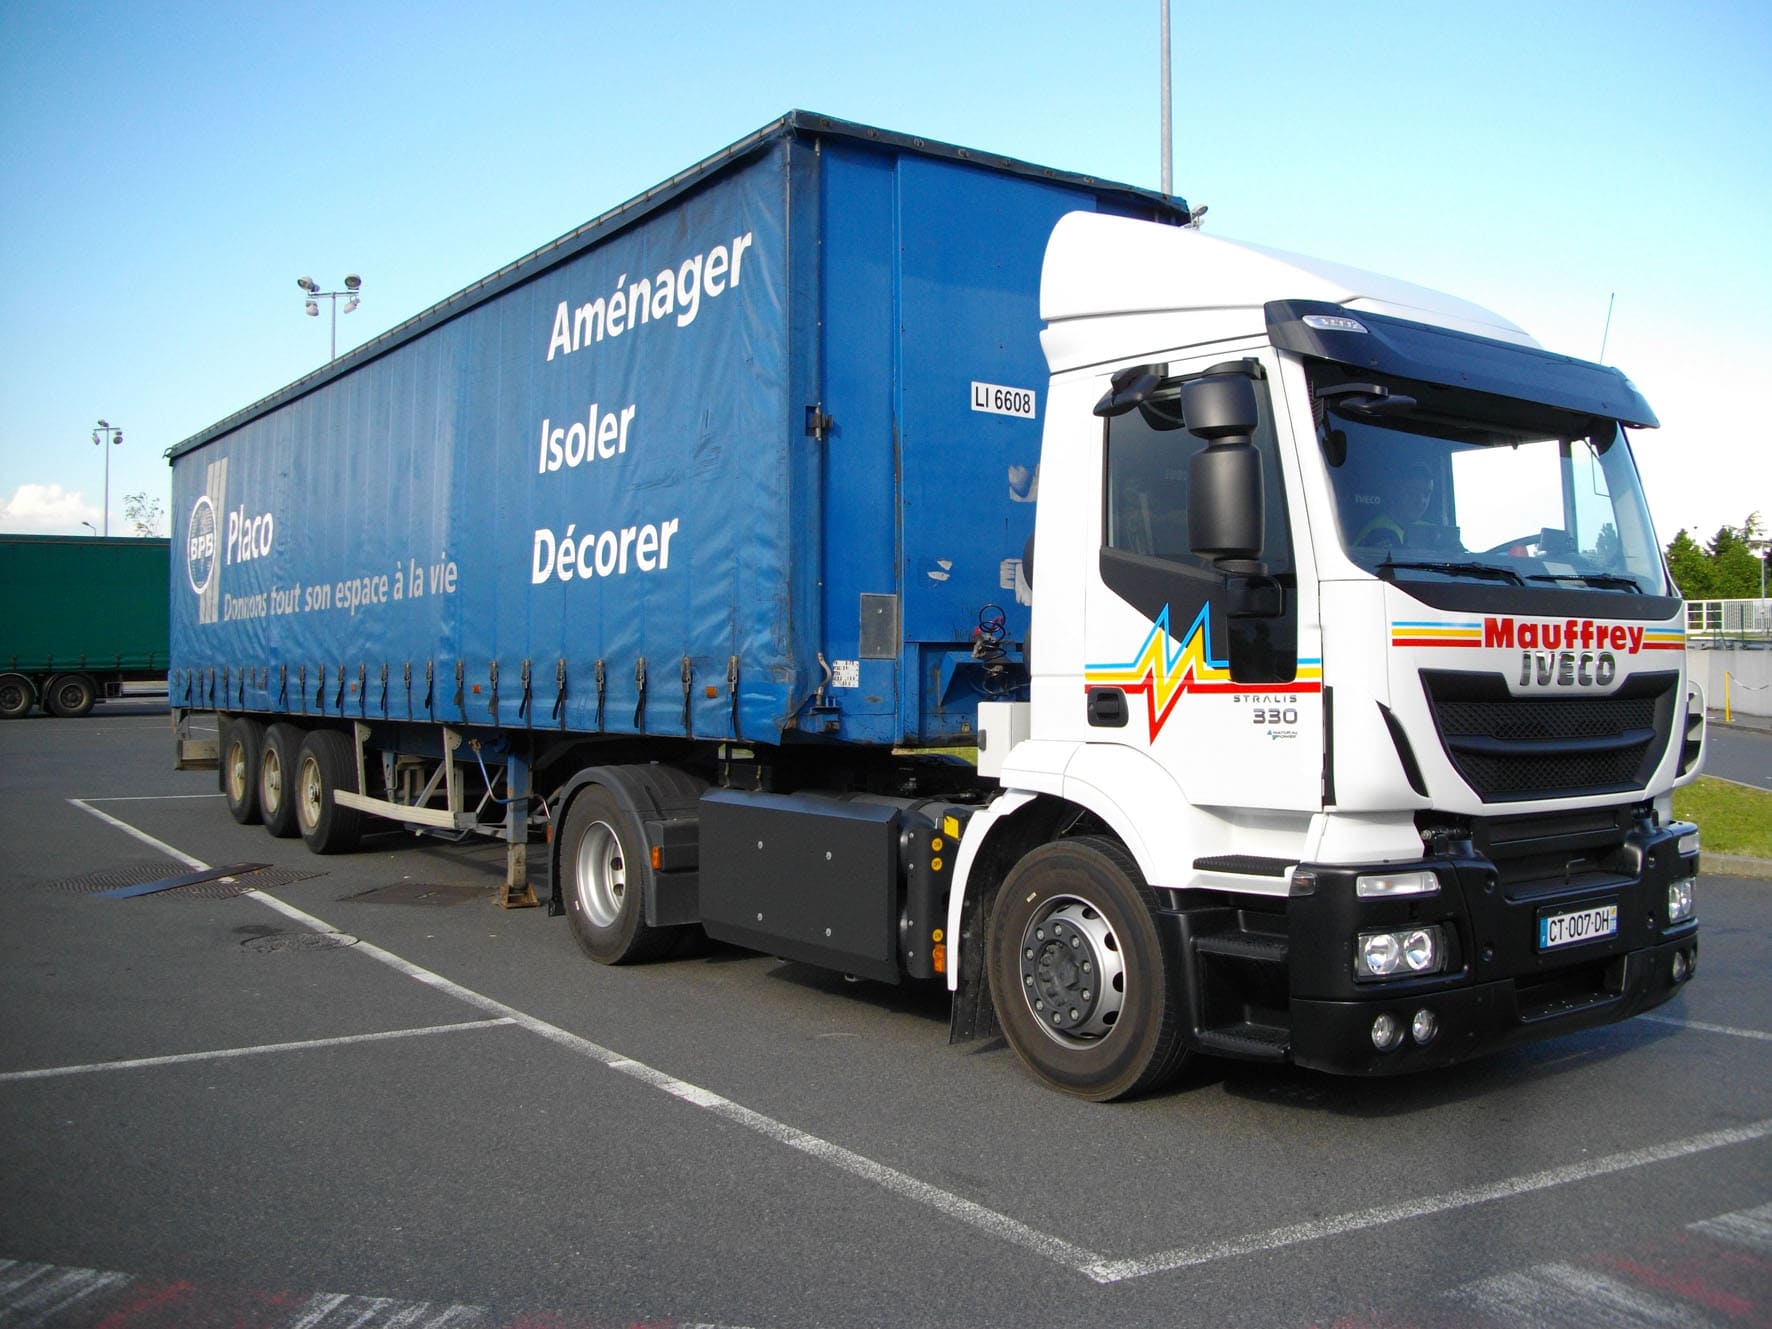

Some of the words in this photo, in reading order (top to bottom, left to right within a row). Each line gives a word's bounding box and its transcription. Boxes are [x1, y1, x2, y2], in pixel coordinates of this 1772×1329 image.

[546, 231, 752, 362] Aménager
[975, 386, 989, 408] LI
[994, 389, 1031, 414] 6608
[538, 403, 636, 474] Isoler
[190, 533, 214, 561] BPB
[226, 504, 273, 565] Placo
[531, 517, 679, 585] Décorer
[223, 593, 267, 621] Donnons
[270, 583, 301, 616] tout
[304, 583, 331, 613] son
[335, 574, 389, 616] espace
[393, 560, 404, 601] à
[408, 558, 424, 599] la
[430, 551, 458, 595] vie
[1484, 617, 1644, 655] Mauffrey
[1519, 650, 1616, 687] IVECO
[1234, 695, 1297, 703] STRALIS
[1253, 708, 1298, 725] 330
